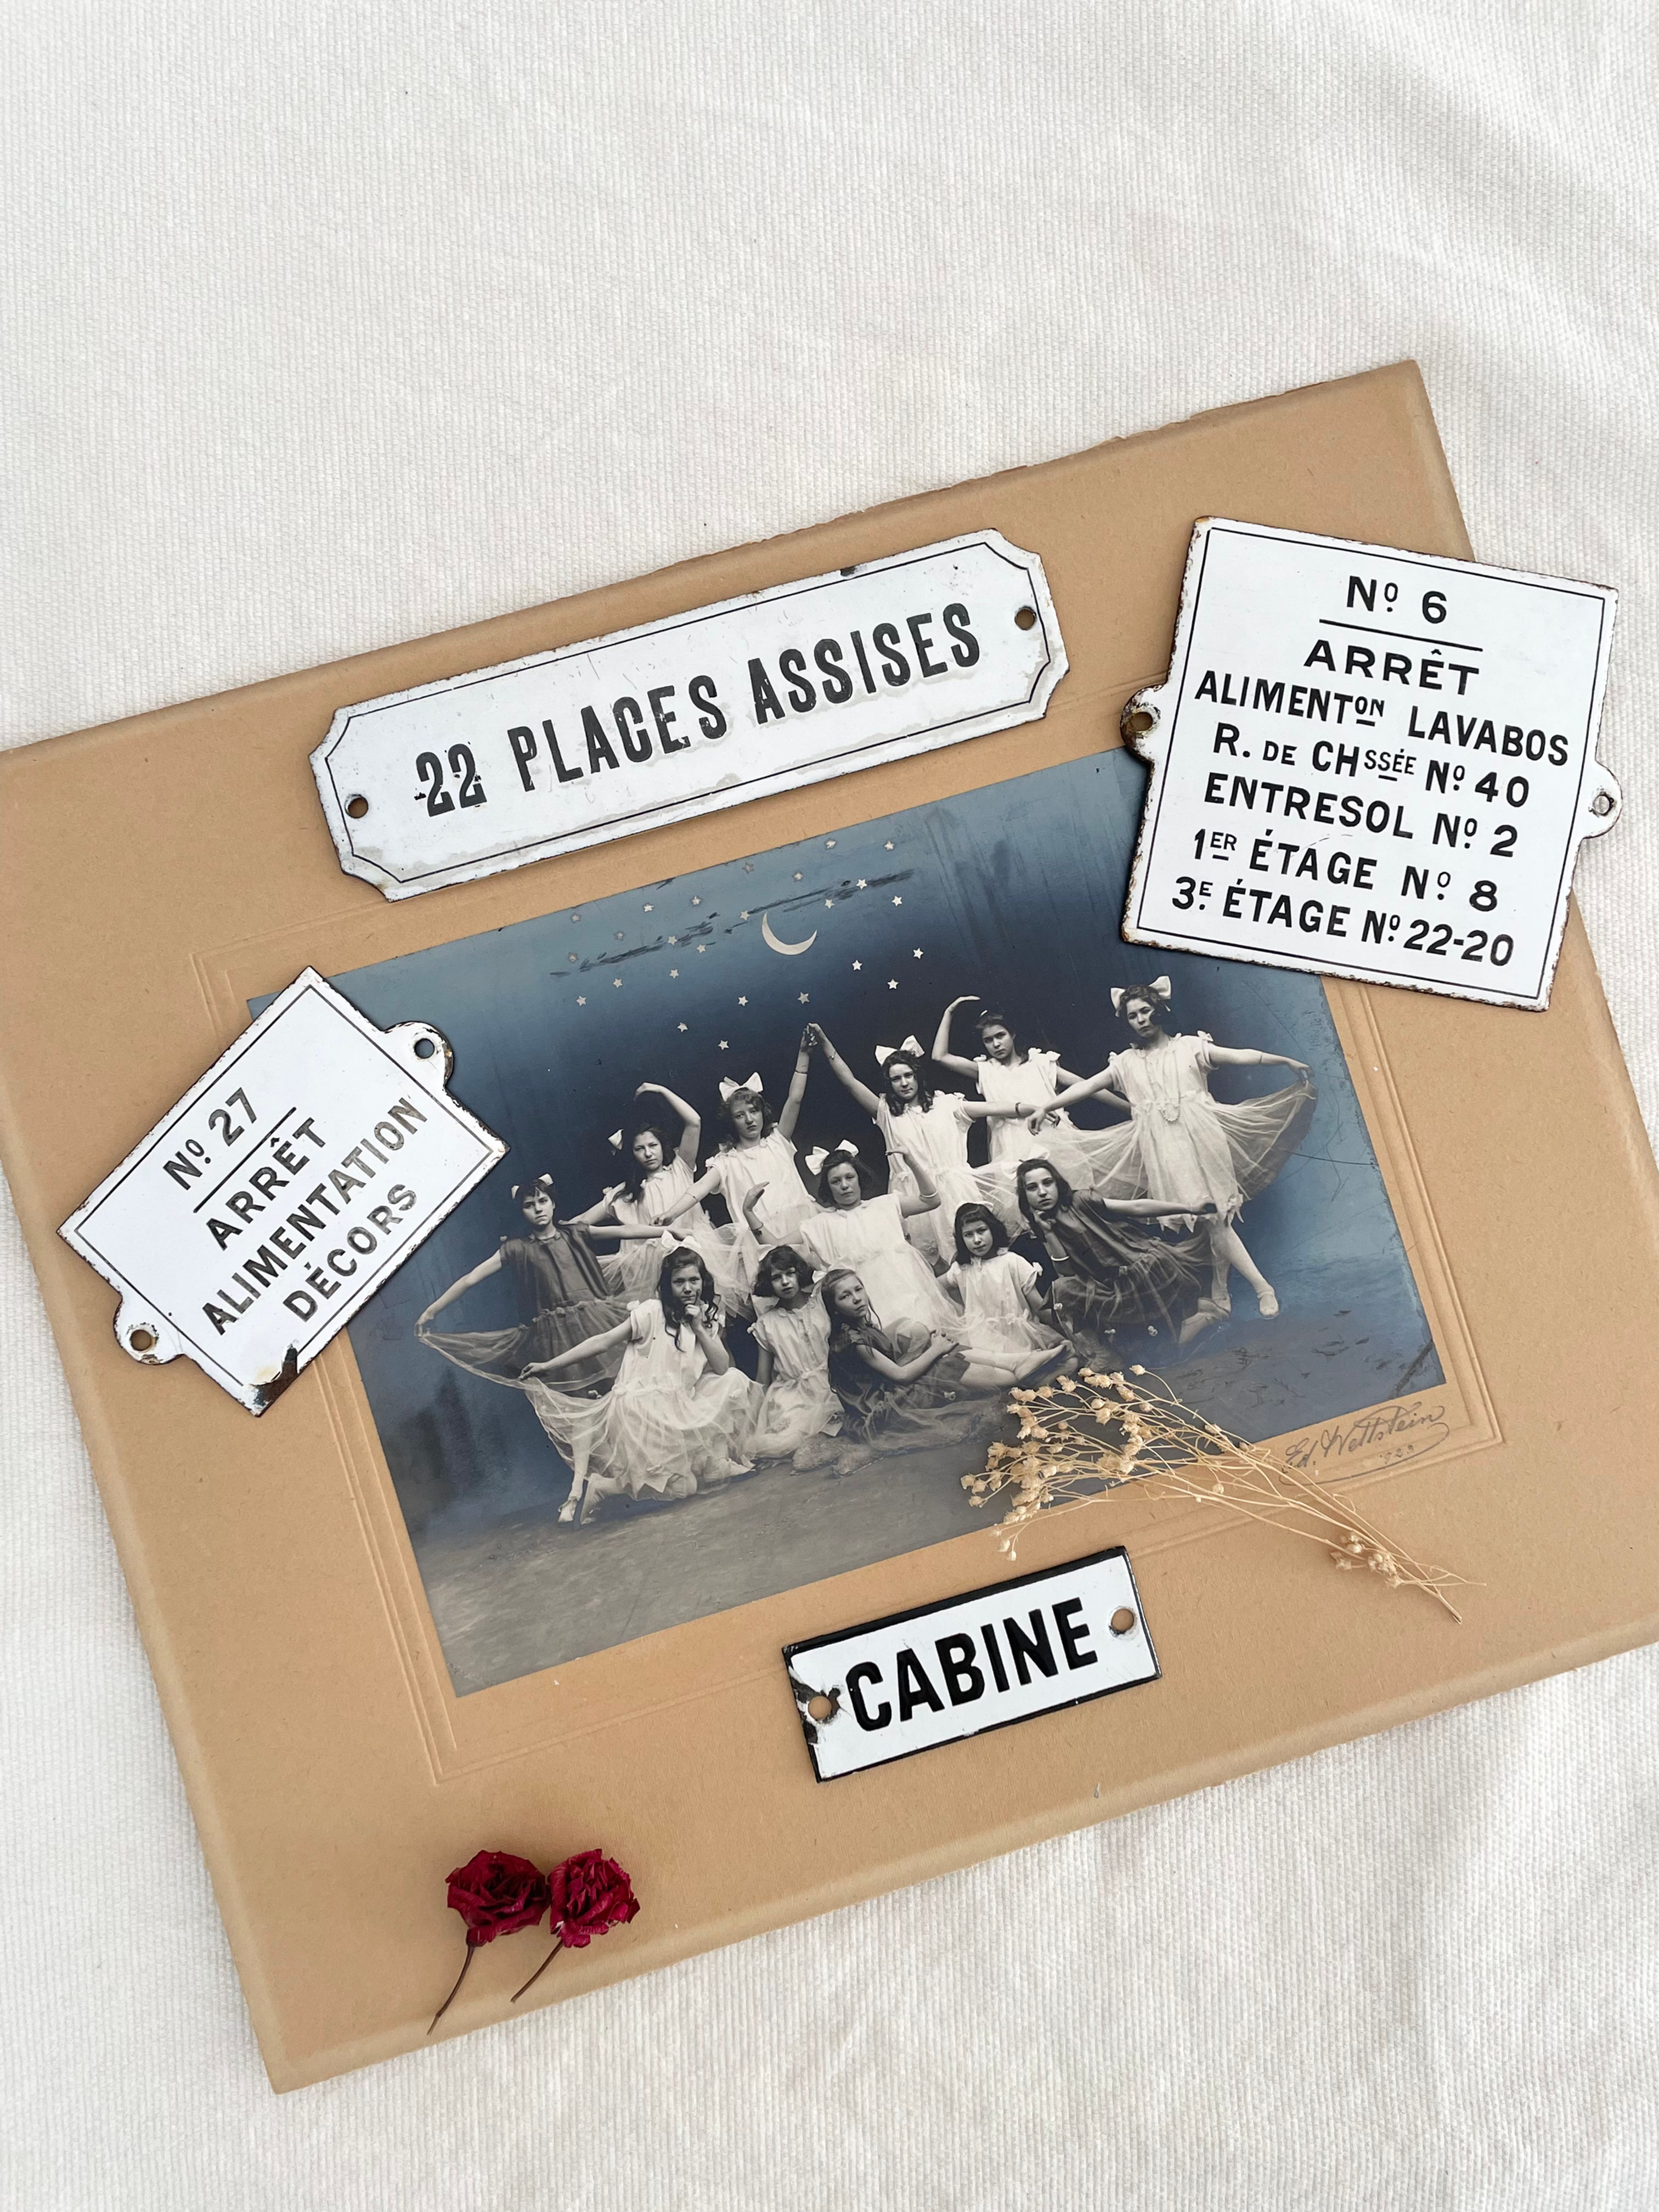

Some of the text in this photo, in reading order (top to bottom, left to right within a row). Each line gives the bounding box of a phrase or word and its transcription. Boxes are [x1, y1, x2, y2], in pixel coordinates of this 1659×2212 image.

[1422, 590, 1448, 624] 6
[1304, 639, 1480, 695] ARRÊT
[416, 603, 979, 817] 22 PLACES ASSISES
[1408, 706, 1567, 765] LAVABOS
[1214, 723, 1250, 757] R.
[1263, 741, 1297, 765] DE
[1475, 772, 1528, 807] 40
[1205, 772, 1413, 839] ENTRESOL
[1491, 825, 1517, 857] 2
[1250, 829, 1376, 889] ÉTAGE
[1470, 881, 1497, 911] 8
[1223, 879, 1350, 936] ÉTAGE
[1404, 919, 1513, 966] 22-20
[209, 1087, 256, 1147] 27
[202, 1097, 427, 1335] ALIMENTATION
[206, 1118, 325, 1250] ARRÊT
[283, 1184, 416, 1322] DÉCORS
[846, 1598, 1098, 1731] CABINE
